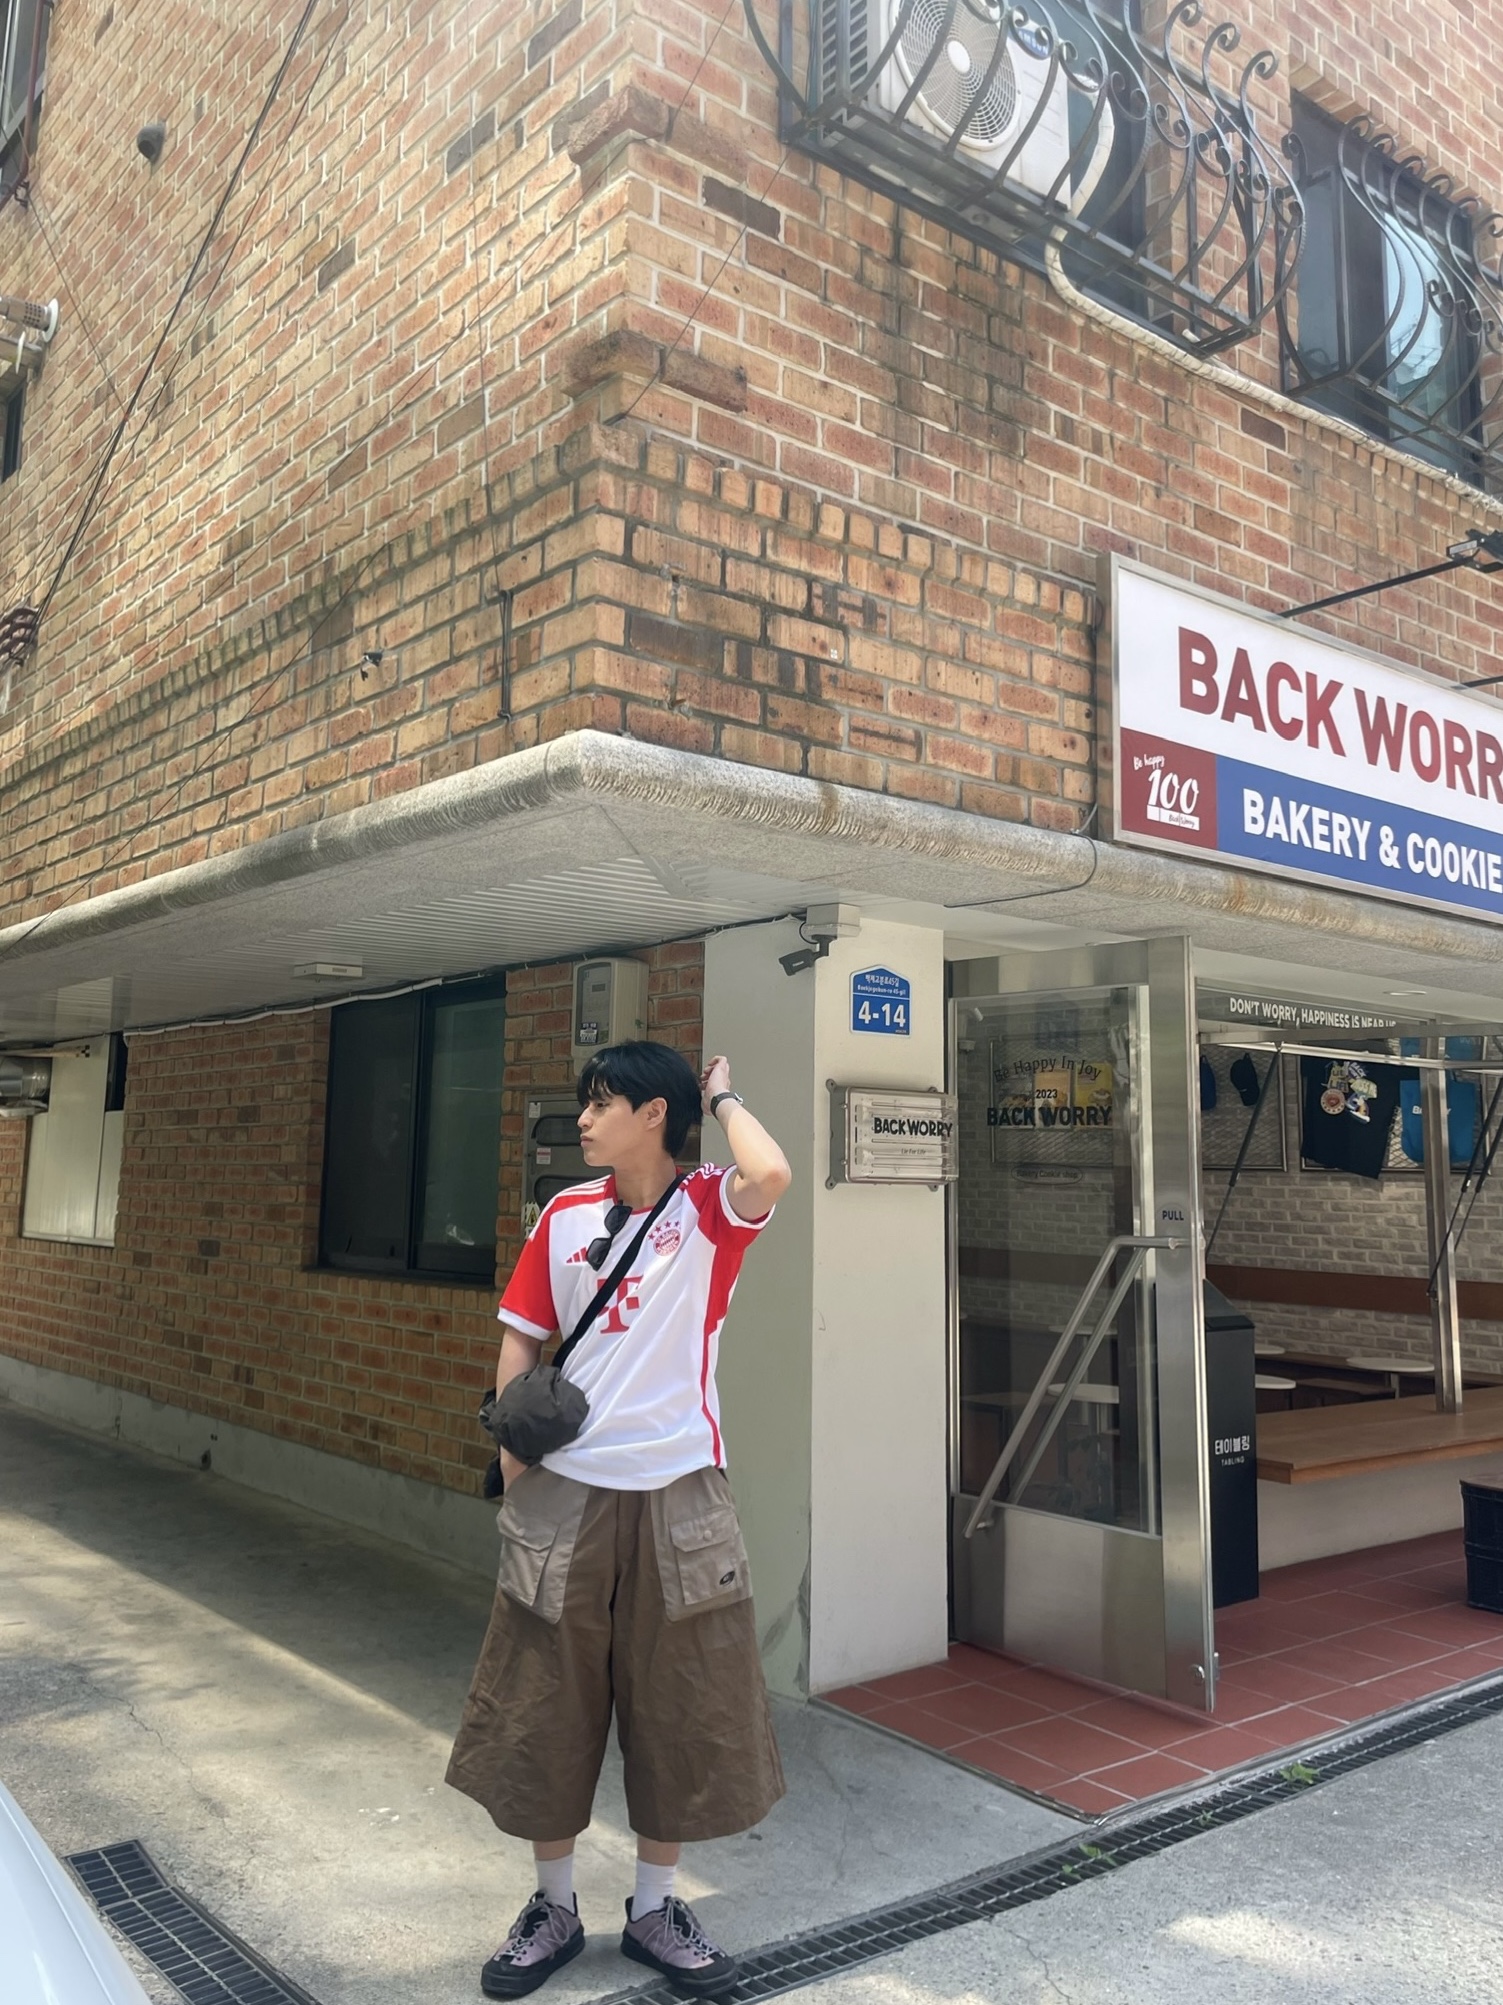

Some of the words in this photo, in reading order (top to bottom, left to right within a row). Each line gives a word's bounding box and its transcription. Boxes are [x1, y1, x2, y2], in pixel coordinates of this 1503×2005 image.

[1178, 625, 1347, 757] BACK
[1353, 687, 1503, 805] WORR
[1143, 753, 1165, 770] happy
[1148, 768, 1199, 815] 100
[1243, 788, 1371, 861] BAKERY
[1379, 825, 1401, 869] &
[1406, 832, 1503, 894] COOKIE
[858, 1000, 906, 1028] 4-14
[1229, 997, 1260, 1017] DON'T
[1261, 1001, 1300, 1025] WORRY,
[1301, 1008, 1350, 1029] HAPPINESS
[1351, 1015, 1360, 1029] IS
[994, 1068, 1011, 1082] Be
[1013, 1057, 1057, 1075] Happy
[1061, 1055, 1075, 1071] In
[1078, 1059, 1102, 1081] Joy
[1035, 1089, 1058, 1099] 2023
[874, 1117, 906, 1135] BACK
[907, 1119, 953, 1137] WORRY
[987, 1107, 1036, 1127] BACK
[1038, 1106, 1112, 1128] WORRY
[1162, 1210, 1184, 1221] PULL
[1214, 1435, 1250, 1455] 테이블링
